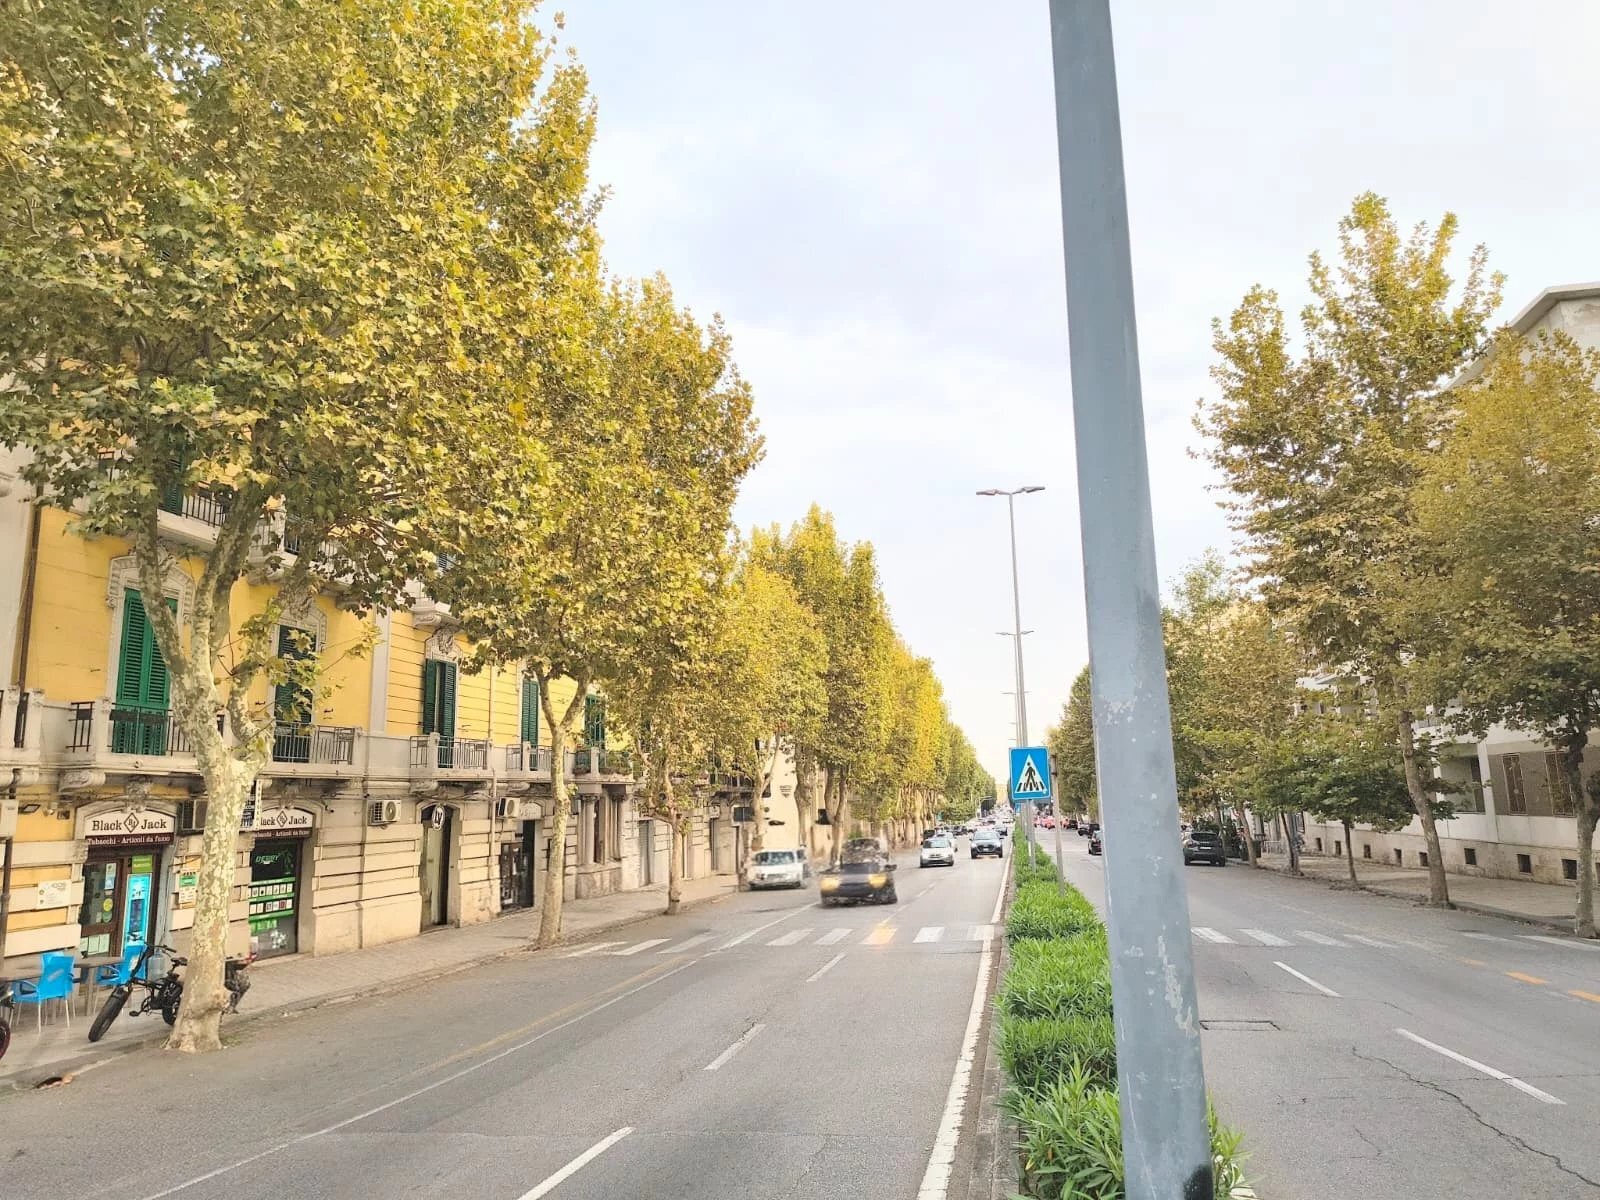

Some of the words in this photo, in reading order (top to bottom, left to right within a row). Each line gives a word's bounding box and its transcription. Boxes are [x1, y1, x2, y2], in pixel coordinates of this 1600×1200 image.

[288, 816, 307, 824] Jack
[92, 820, 122, 831] Black
[141, 819, 167, 830] Jack
[87, 836, 116, 845] Tabacchi
